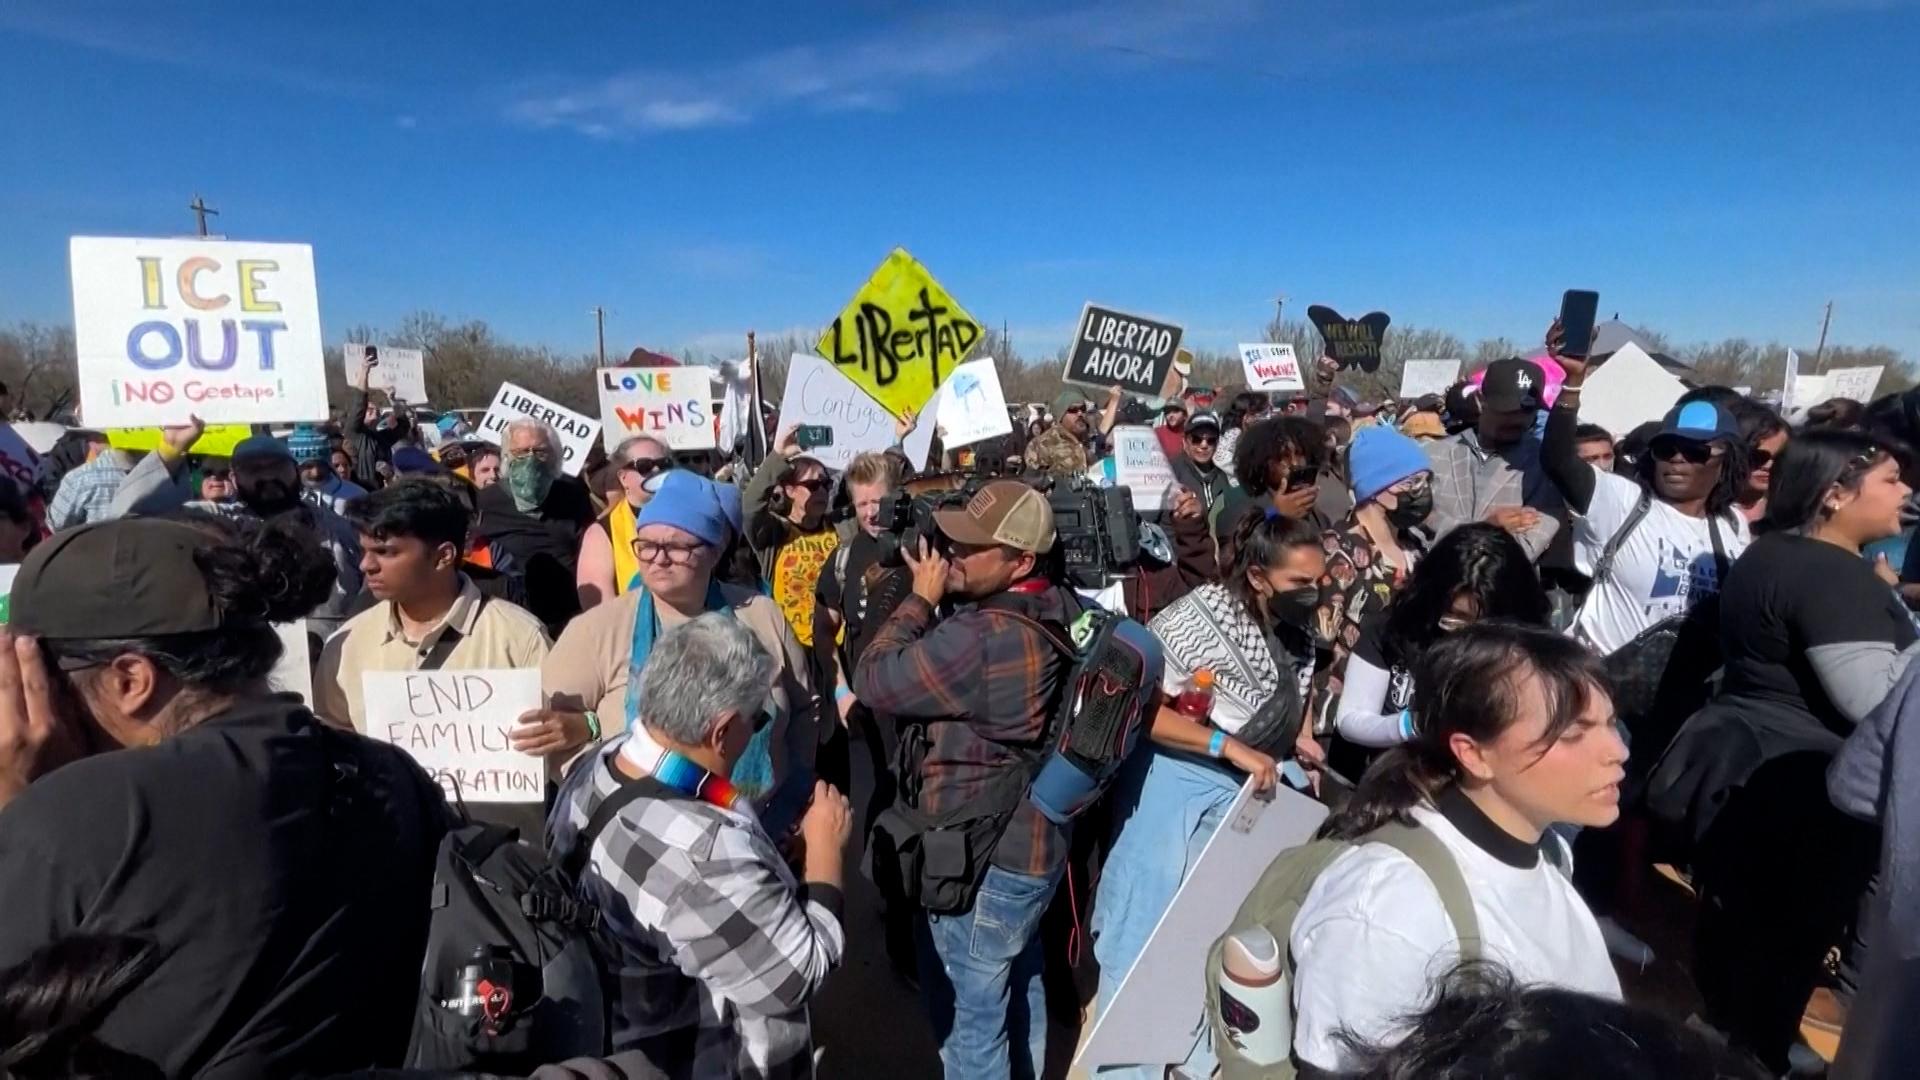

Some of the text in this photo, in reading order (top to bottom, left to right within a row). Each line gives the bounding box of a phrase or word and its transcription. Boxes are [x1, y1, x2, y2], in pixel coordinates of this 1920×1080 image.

[137, 256, 283, 312] ICE
[126, 319, 288, 371] OUT
[1083, 313, 1172, 357] LIBERTAD
[604, 373, 672, 392] LOVE
[1083, 347, 1155, 386] AHORA
[1517, 369, 1533, 388] LA
[183, 377, 285, 403] Gestapo!
[500, 391, 590, 439] LIBERTAD
[615, 400, 705, 431] WINS
[406, 675, 493, 717] END
[387, 721, 513, 753] FAMILY
